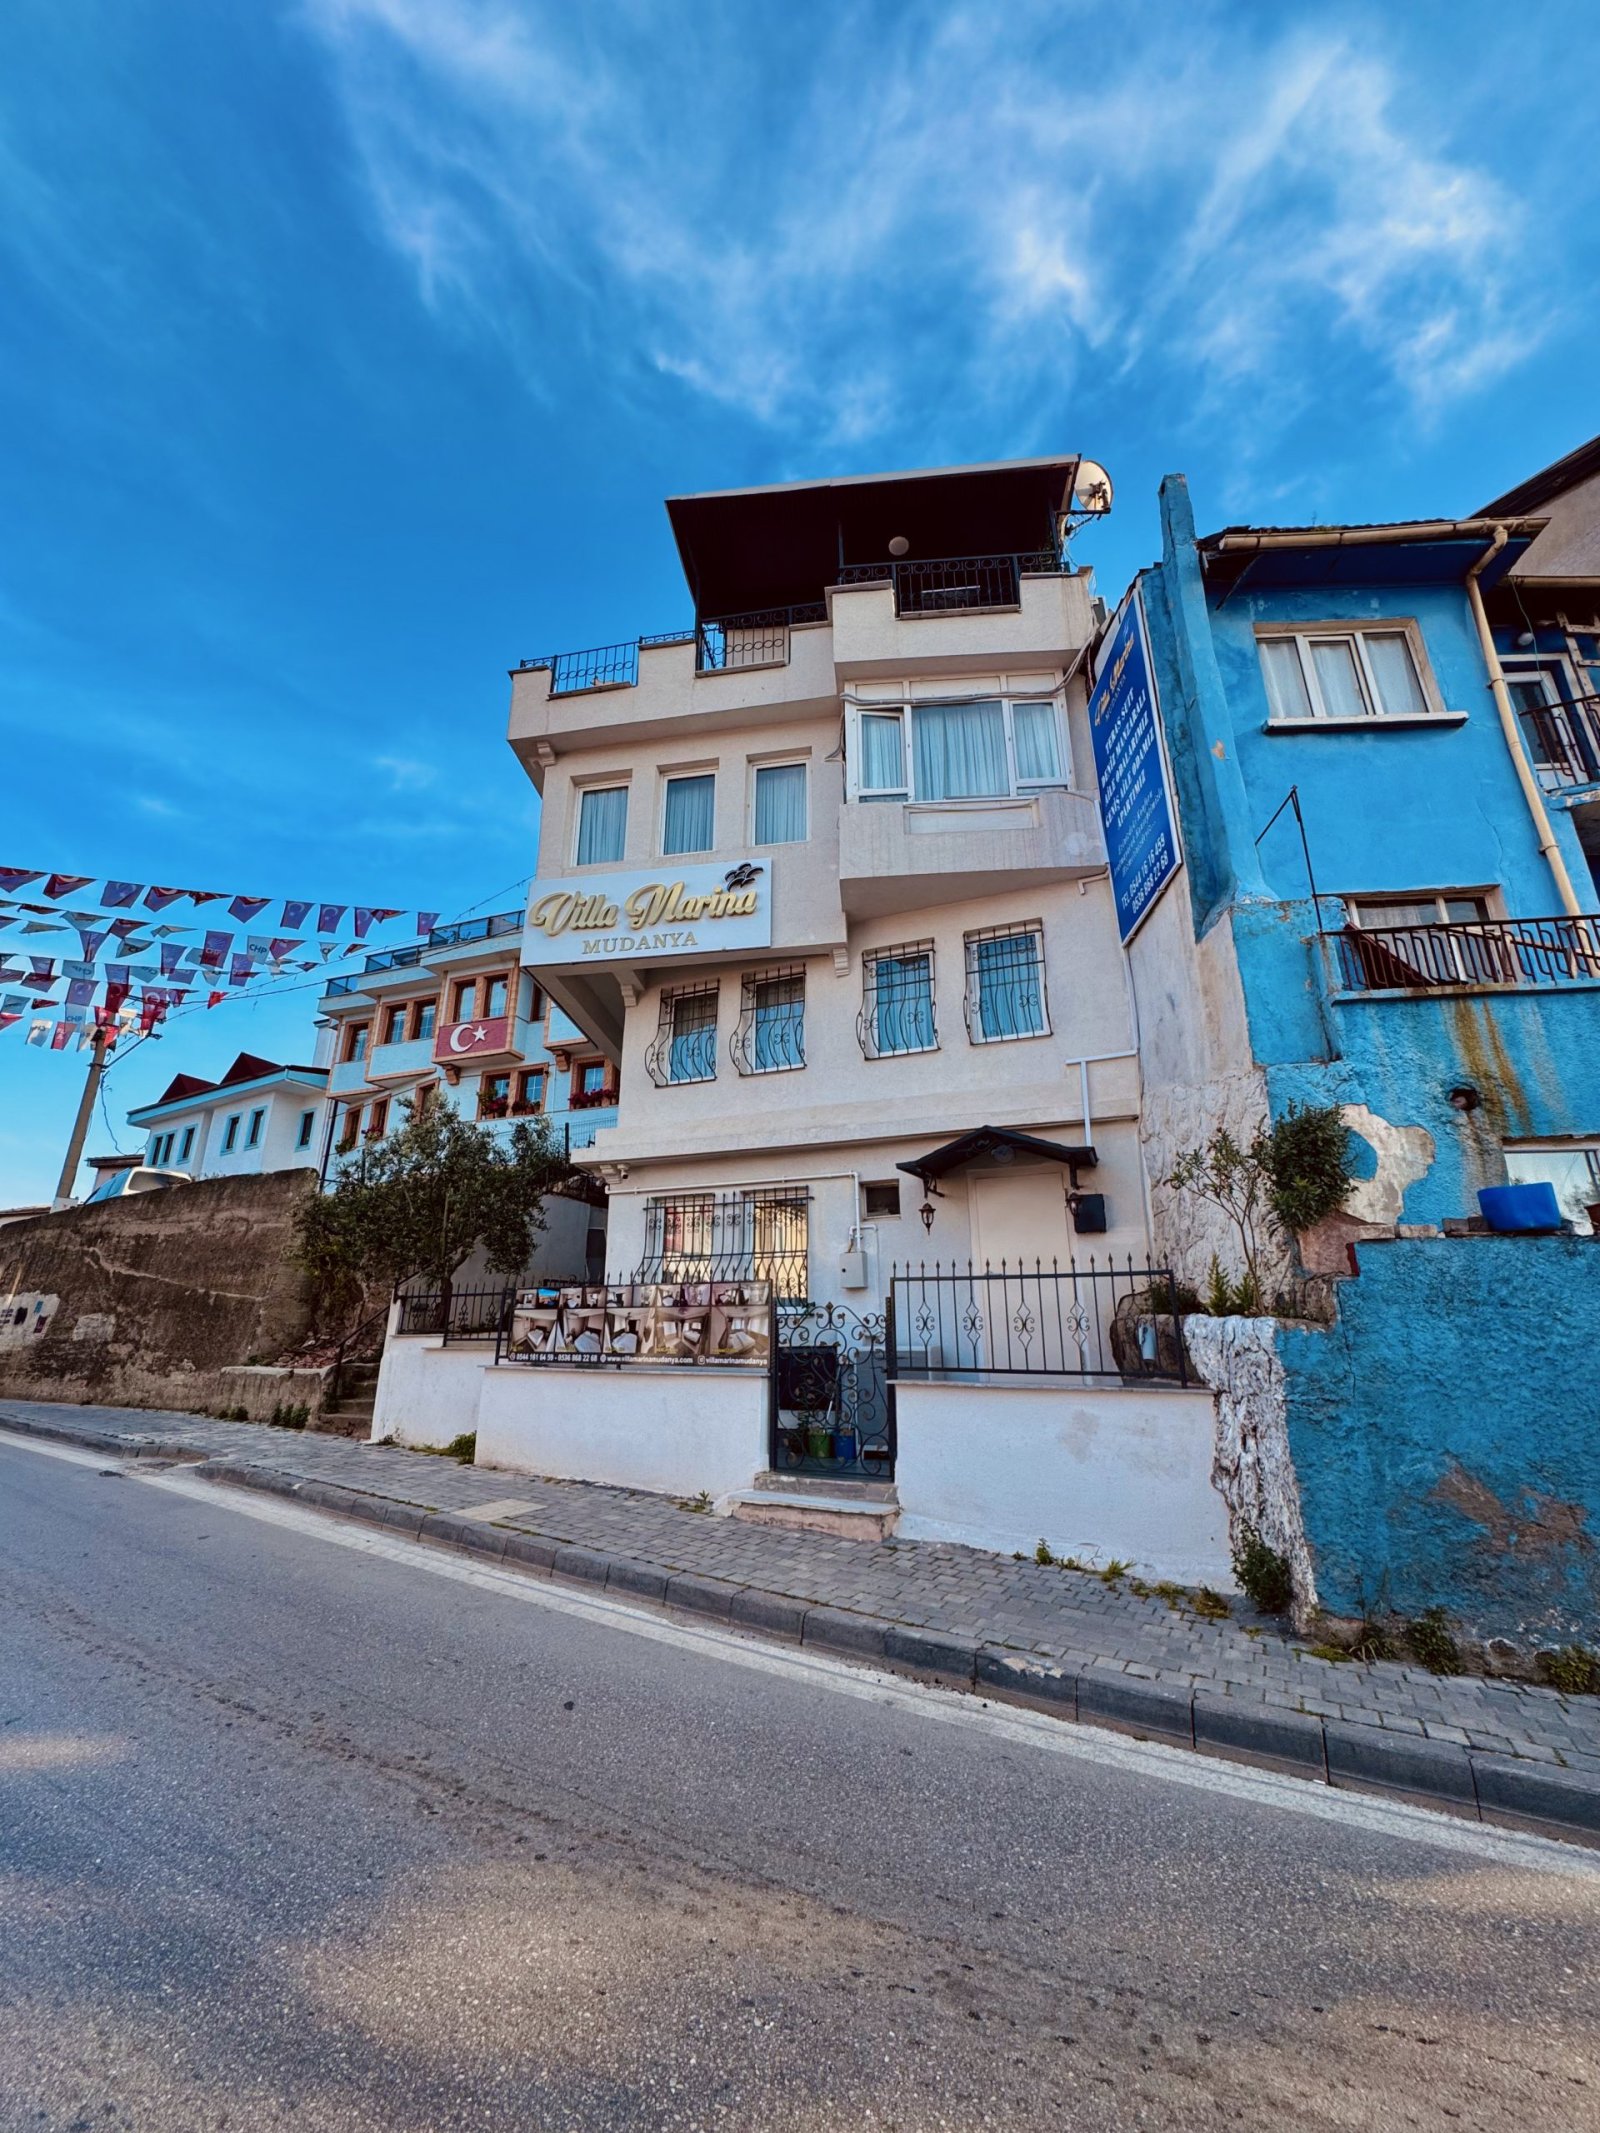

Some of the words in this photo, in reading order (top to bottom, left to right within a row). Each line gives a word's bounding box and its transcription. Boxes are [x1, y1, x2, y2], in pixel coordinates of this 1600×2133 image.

[1101, 753, 1116, 789] DENİZ
[1115, 689, 1146, 758] MANZARALI
[1105, 717, 1120, 755] TERAS
[1105, 777, 1115, 807] AİLE
[1115, 709, 1148, 785] ODALARIMIZ
[1105, 795, 1120, 830] GENİŞ
[1120, 767, 1131, 801] AİLE
[1131, 726, 1154, 777] ODAMIZ
[1117, 769, 1146, 828] APARTIMIZ
[1130, 871, 1141, 897] 0544
[1141, 859, 1148, 878] 16
[1148, 848, 1155, 867] 16
[1154, 832, 1165, 857] 459
[1132, 887, 1144, 914] 0536
[1153, 860, 1161, 881] 22
[1160, 849, 1168, 871] 68
[529, 891, 618, 937] Villa
[624, 881, 757, 930] Marina
[249, 943, 267, 954] CHP
[582, 931, 698, 955] MUDANYA
[558, 1354, 571, 1362] 0536
[706, 1357, 767, 1366] villamarinamudanya
